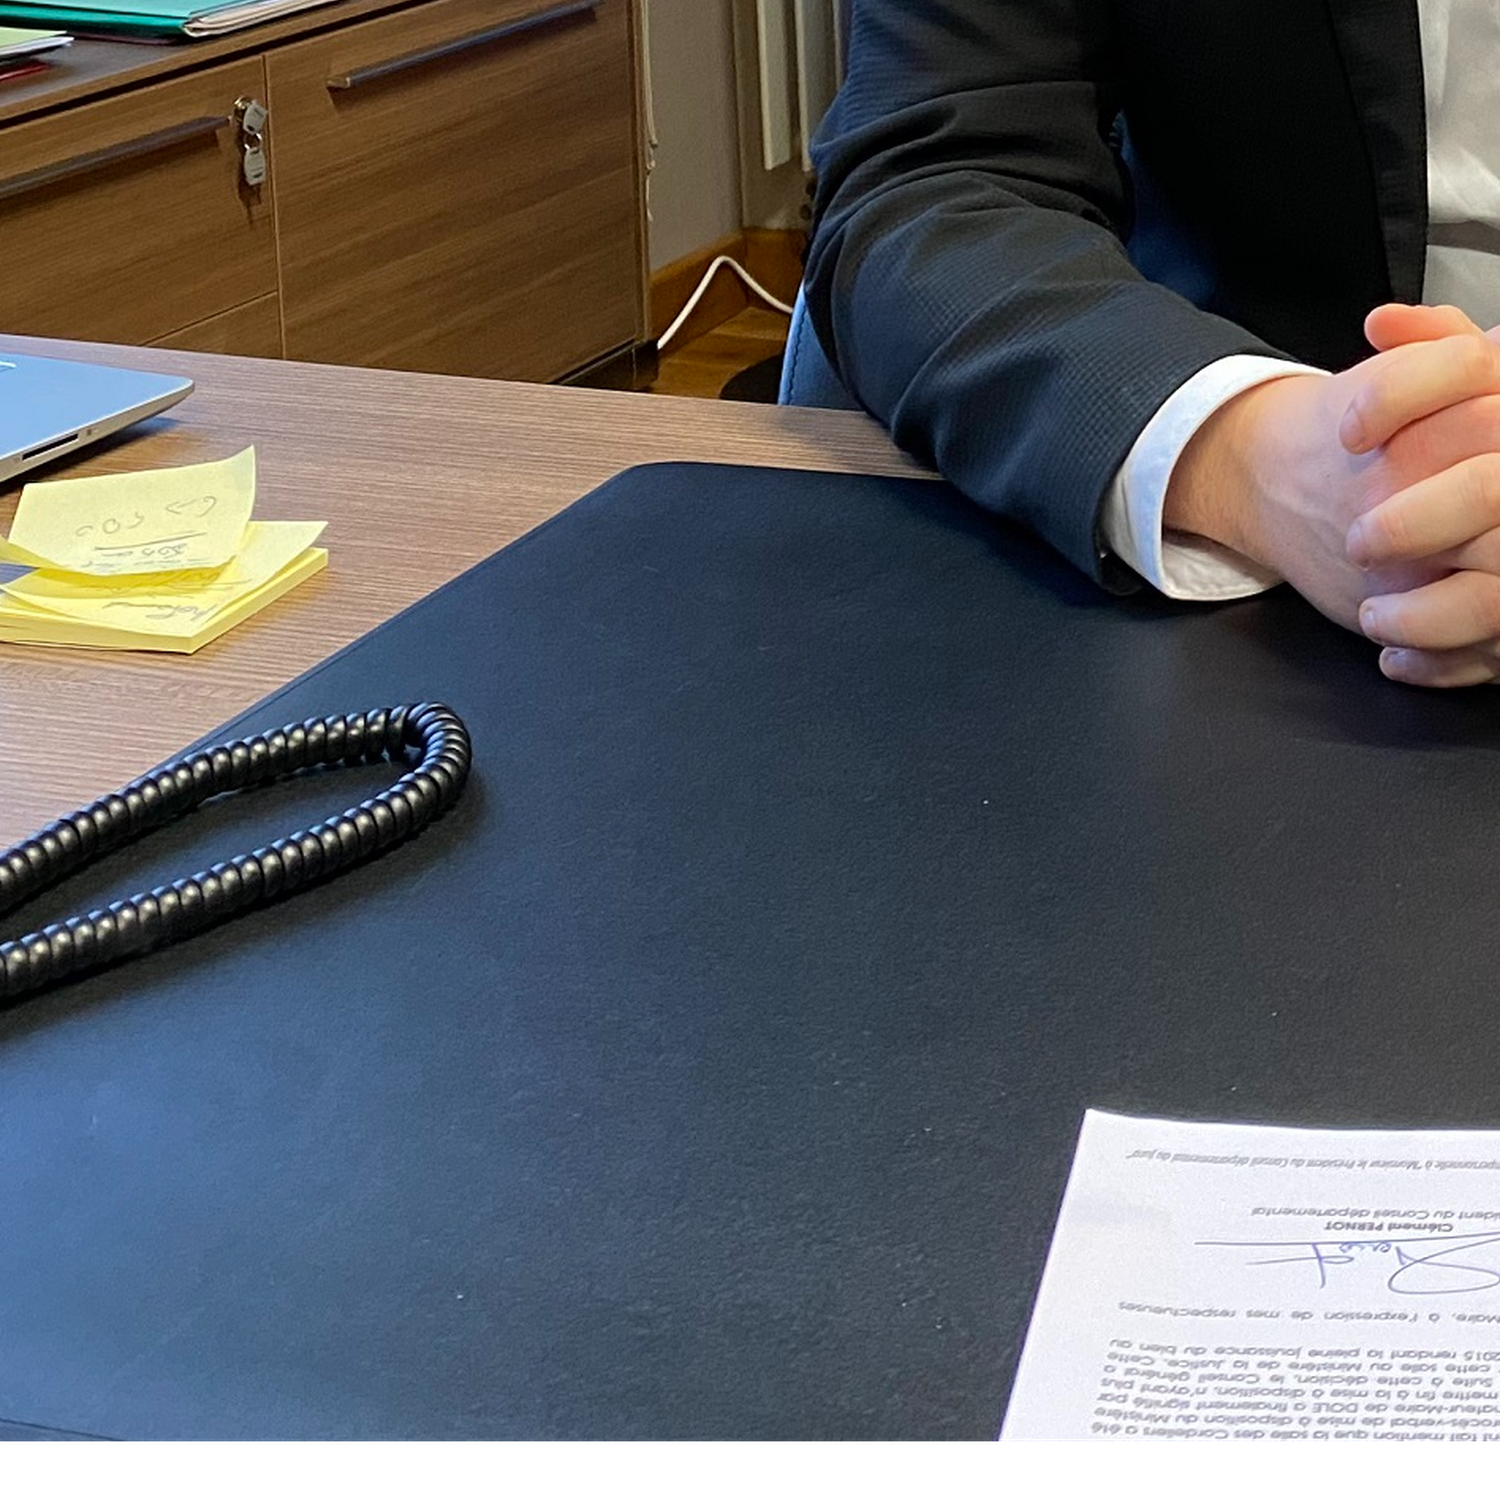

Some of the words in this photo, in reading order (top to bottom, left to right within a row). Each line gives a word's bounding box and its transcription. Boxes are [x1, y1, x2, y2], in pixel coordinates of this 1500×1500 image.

[1251, 1207, 1370, 1218] départemental
[1373, 1209, 1430, 1219] Conseil
[1435, 1211, 1455, 1220] du
[1325, 1222, 1384, 1231] PERNOT
[1388, 1223, 1453, 1233] Clément
[1118, 1302, 1236, 1318] respectueuses
[1247, 1310, 1280, 1318] mes
[1291, 1311, 1313, 1321] de
[1428, 1314, 1440, 1323] à
[1109, 1339, 1133, 1349] au
[1140, 1343, 1177, 1356] bien
[1184, 1347, 1207, 1357] du
[1215, 1347, 1301, 1358] jouissance
[1308, 1348, 1360, 1359] pleine
[1367, 1350, 1383, 1359] la
[1107, 1352, 1155, 1366] Cette
[1391, 1351, 1456, 1360] rendant
[1104, 1365, 1116, 1373] a
[1163, 1359, 1225, 1369] Justice.
[1233, 1361, 1249, 1370] la
[1257, 1361, 1281, 1371] de
[1288, 1362, 1362, 1372] Ministère
[1370, 1363, 1393, 1371] au
[1400, 1363, 1437, 1373] salle
[1445, 1364, 1490, 1373] cette
[1123, 1367, 1190, 1383] général
[1198, 1373, 1260, 1384] Conseil
[1270, 1375, 1284, 1384] le
[1292, 1374, 1368, 1385] décision,
[1100, 1378, 1134, 1389] plus
[1377, 1376, 1422, 1385] cette
[1431, 1377, 1443, 1386] à
[1452, 1378, 1493, 1387] Suite
[1214, 1386, 1305, 1398] disposition,
[1312, 1389, 1324, 1399] à
[1330, 1389, 1368, 1398] mise
[1374, 1390, 1390, 1399] la
[1397, 1390, 1409, 1400] à
[1416, 1391, 1436, 1400] fin
[1443, 1391, 1498, 1400] mettre
[1097, 1393, 1128, 1403] par
[1133, 1396, 1190, 1410] signifié
[1197, 1401, 1288, 1412] finalement
[1294, 1403, 1306, 1411] a
[1312, 1403, 1358, 1413] DOLE
[1365, 1403, 1387, 1413] de
[1095, 1407, 1170, 1423] Ministère
[1176, 1414, 1198, 1424] du
[1204, 1415, 1292, 1426] disposition
[1299, 1417, 1311, 1427] à
[1317, 1417, 1356, 1426] mise
[1362, 1418, 1385, 1427] de
